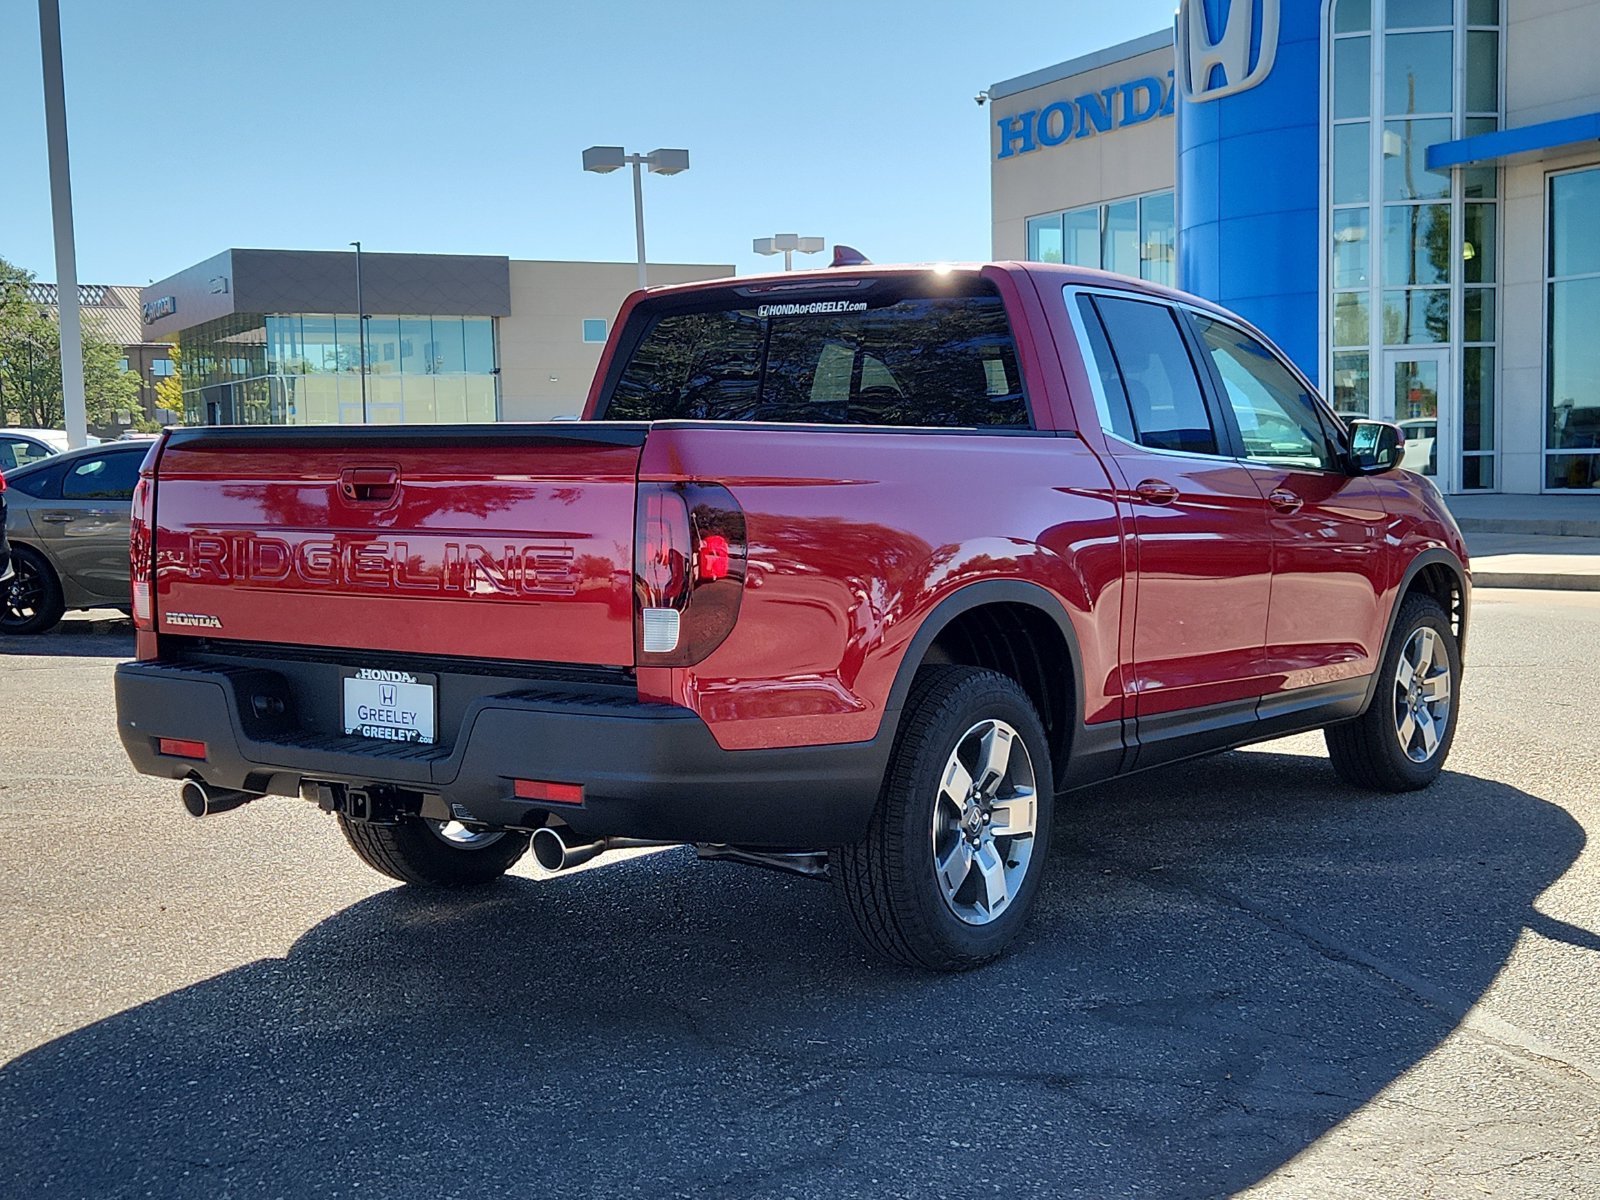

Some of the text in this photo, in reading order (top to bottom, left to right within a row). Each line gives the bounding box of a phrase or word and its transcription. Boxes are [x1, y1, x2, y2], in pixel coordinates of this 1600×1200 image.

[187, 534, 577, 596] RIDGELINE
[165, 611, 222, 629] HONDA
[360, 668, 411, 682] HONDA
[358, 705, 417, 725] GREELEY
[362, 726, 411, 741] GREELEY
